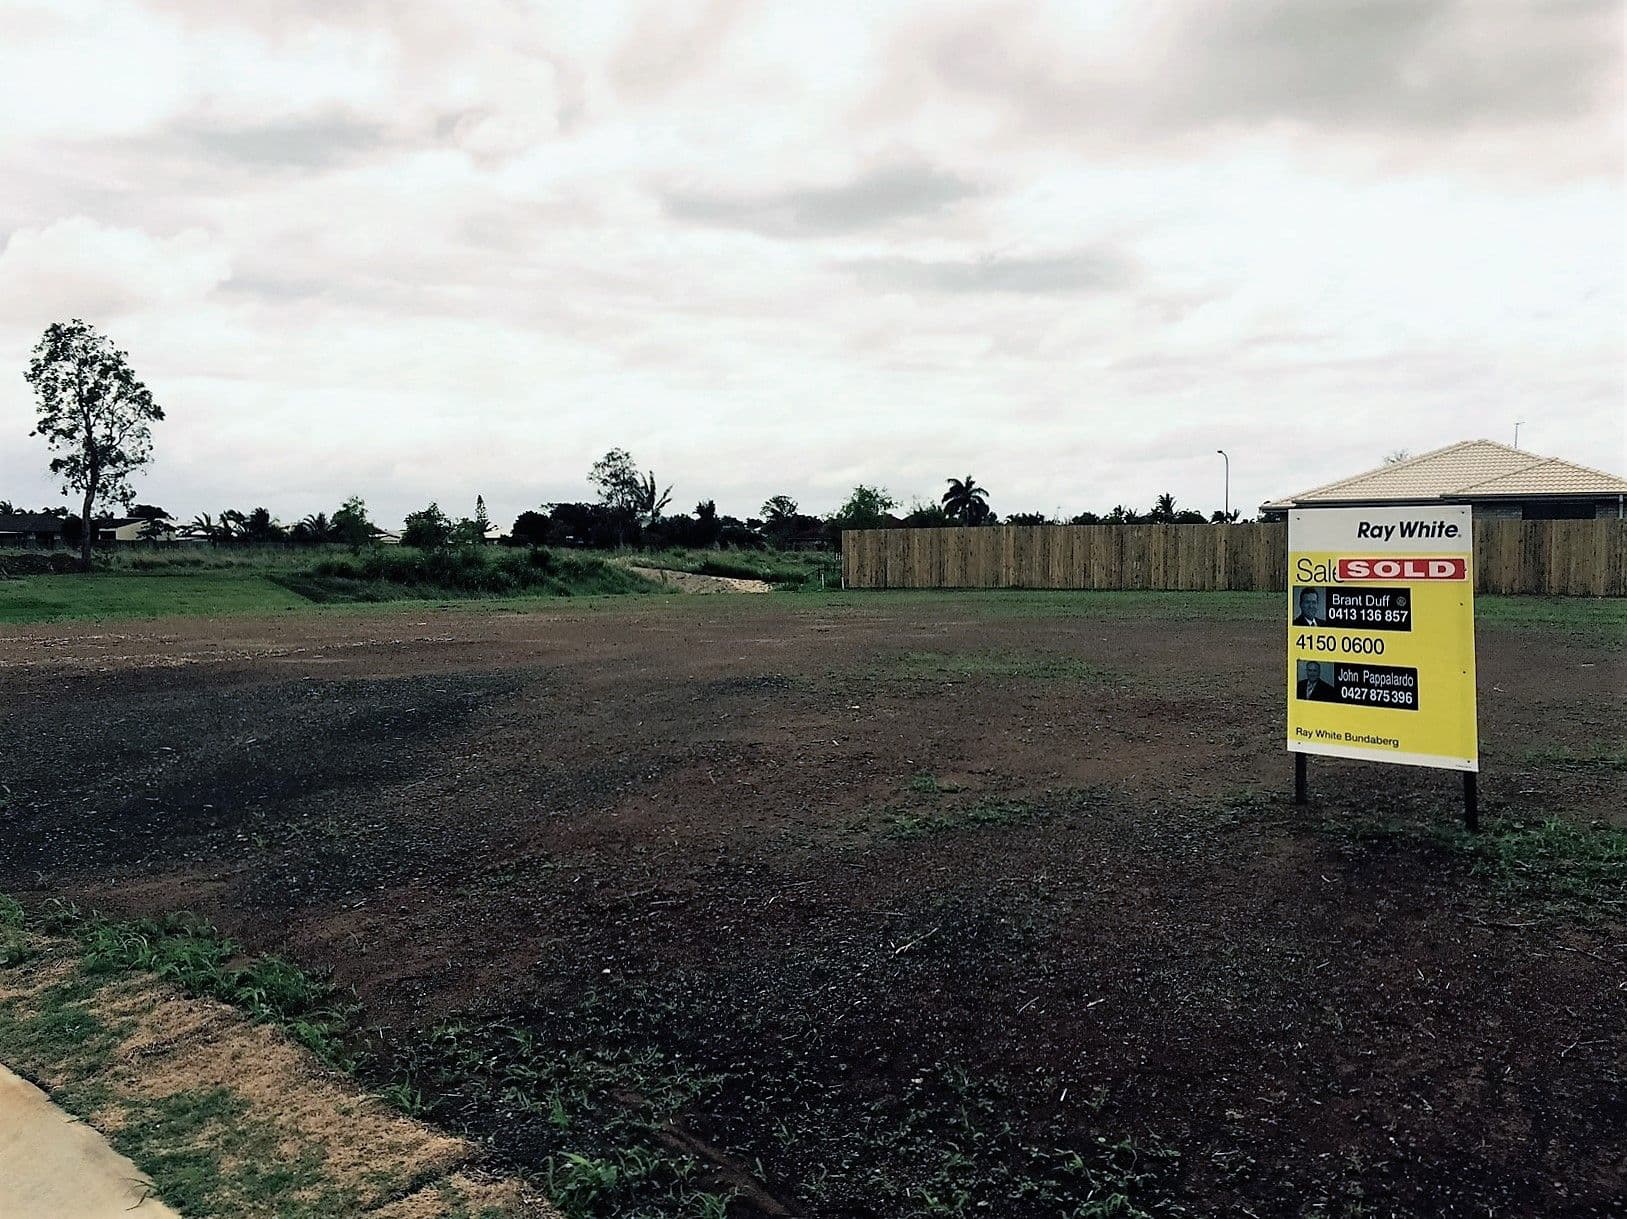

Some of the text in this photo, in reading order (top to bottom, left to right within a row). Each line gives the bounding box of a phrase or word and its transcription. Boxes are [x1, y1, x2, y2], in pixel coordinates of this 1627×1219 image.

[1357, 522, 1395, 542] Ray
[1347, 561, 1456, 577] SOLD
[1332, 594, 1390, 607] Brant Duff
[1328, 608, 1408, 623] 0413 136 857
[1296, 634, 1384, 654] 4150 0600
[1338, 669, 1413, 687] John Pappalardo
[1341, 686, 1413, 704] 0427 875 396
[1296, 727, 1399, 748] Ray White Bundaberg
